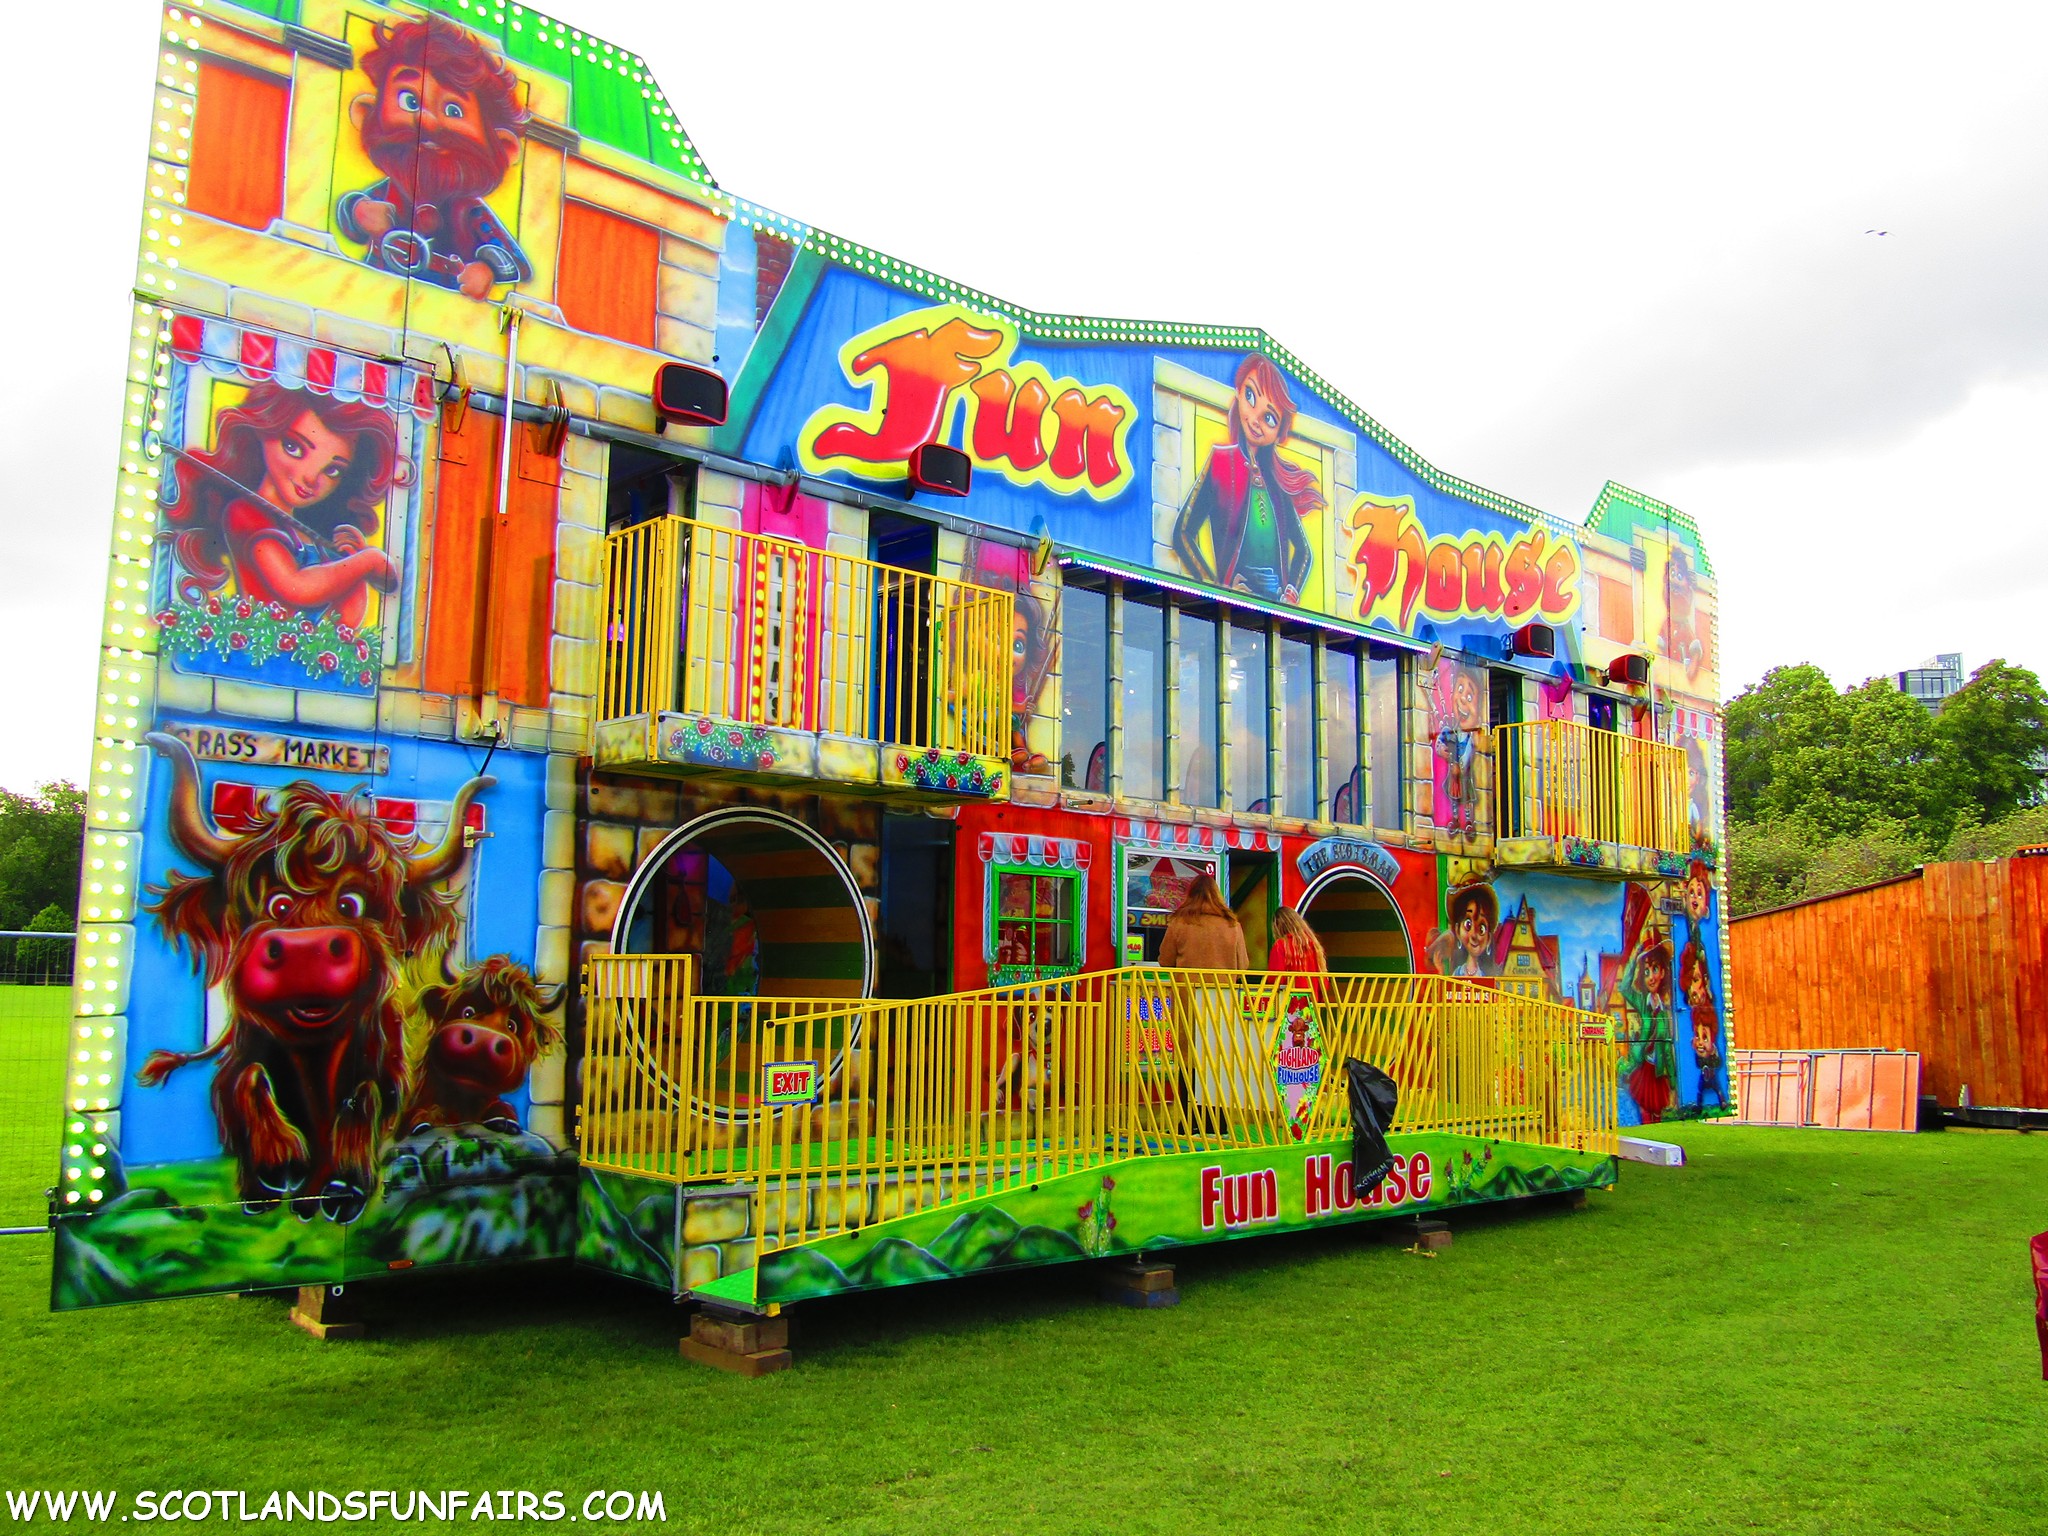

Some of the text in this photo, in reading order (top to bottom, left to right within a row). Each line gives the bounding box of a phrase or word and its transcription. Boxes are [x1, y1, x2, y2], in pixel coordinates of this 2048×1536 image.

[811, 316, 1127, 489] Fun
[284, 738, 376, 770] MARKET
[1303, 842, 1395, 881] THE SCOTSMAN
[1243, 995, 1271, 1013] EIT
[1277, 1046, 1319, 1070] HIGHLAND
[772, 1071, 811, 1096] EXIT
[1276, 1064, 1320, 1084] FUNHOUSE
[1201, 1152, 1432, 1232] Fun Hose
